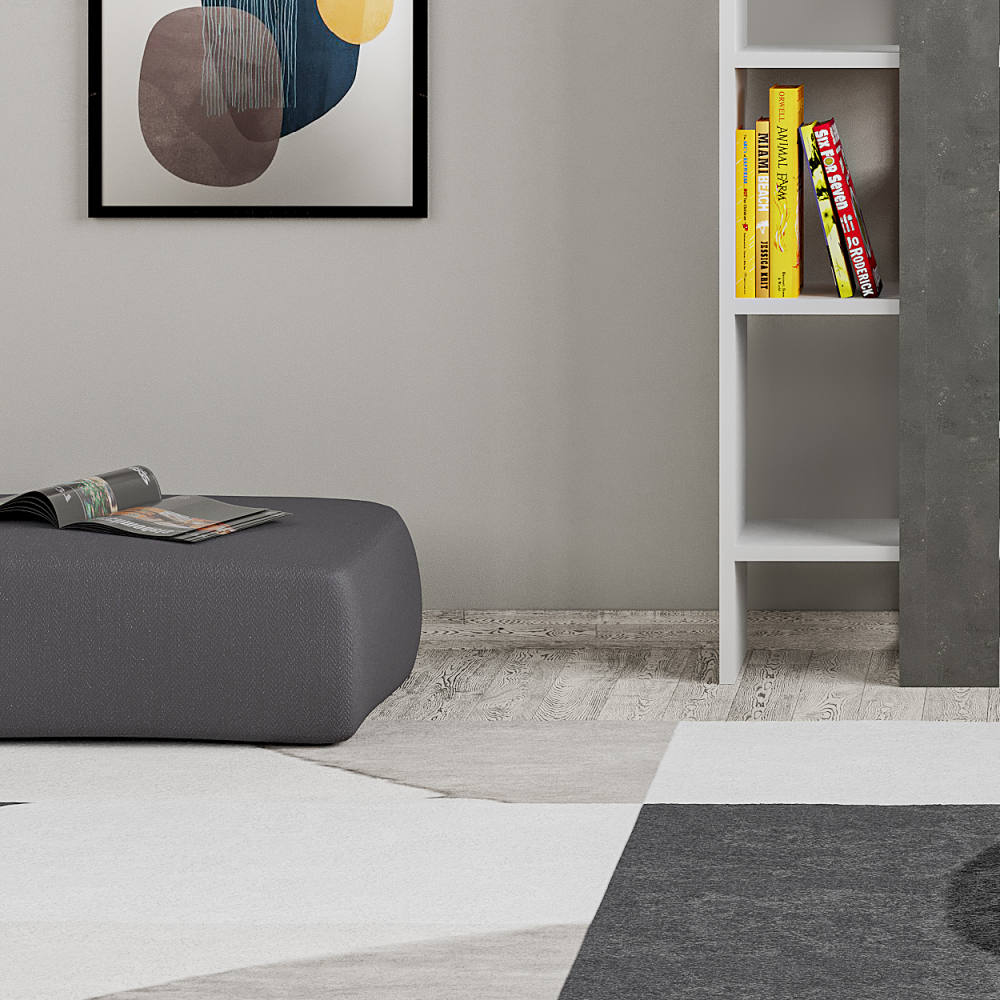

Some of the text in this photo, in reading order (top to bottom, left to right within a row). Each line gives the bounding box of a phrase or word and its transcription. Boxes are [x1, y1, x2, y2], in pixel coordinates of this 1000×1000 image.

[757, 132, 768, 211] MIAMI BEACH
[776, 125, 788, 201] ANIMAL FARM
[820, 149, 838, 173] FOR
[759, 240, 768, 270] JESSICA
[849, 246, 875, 297] RODERICK
